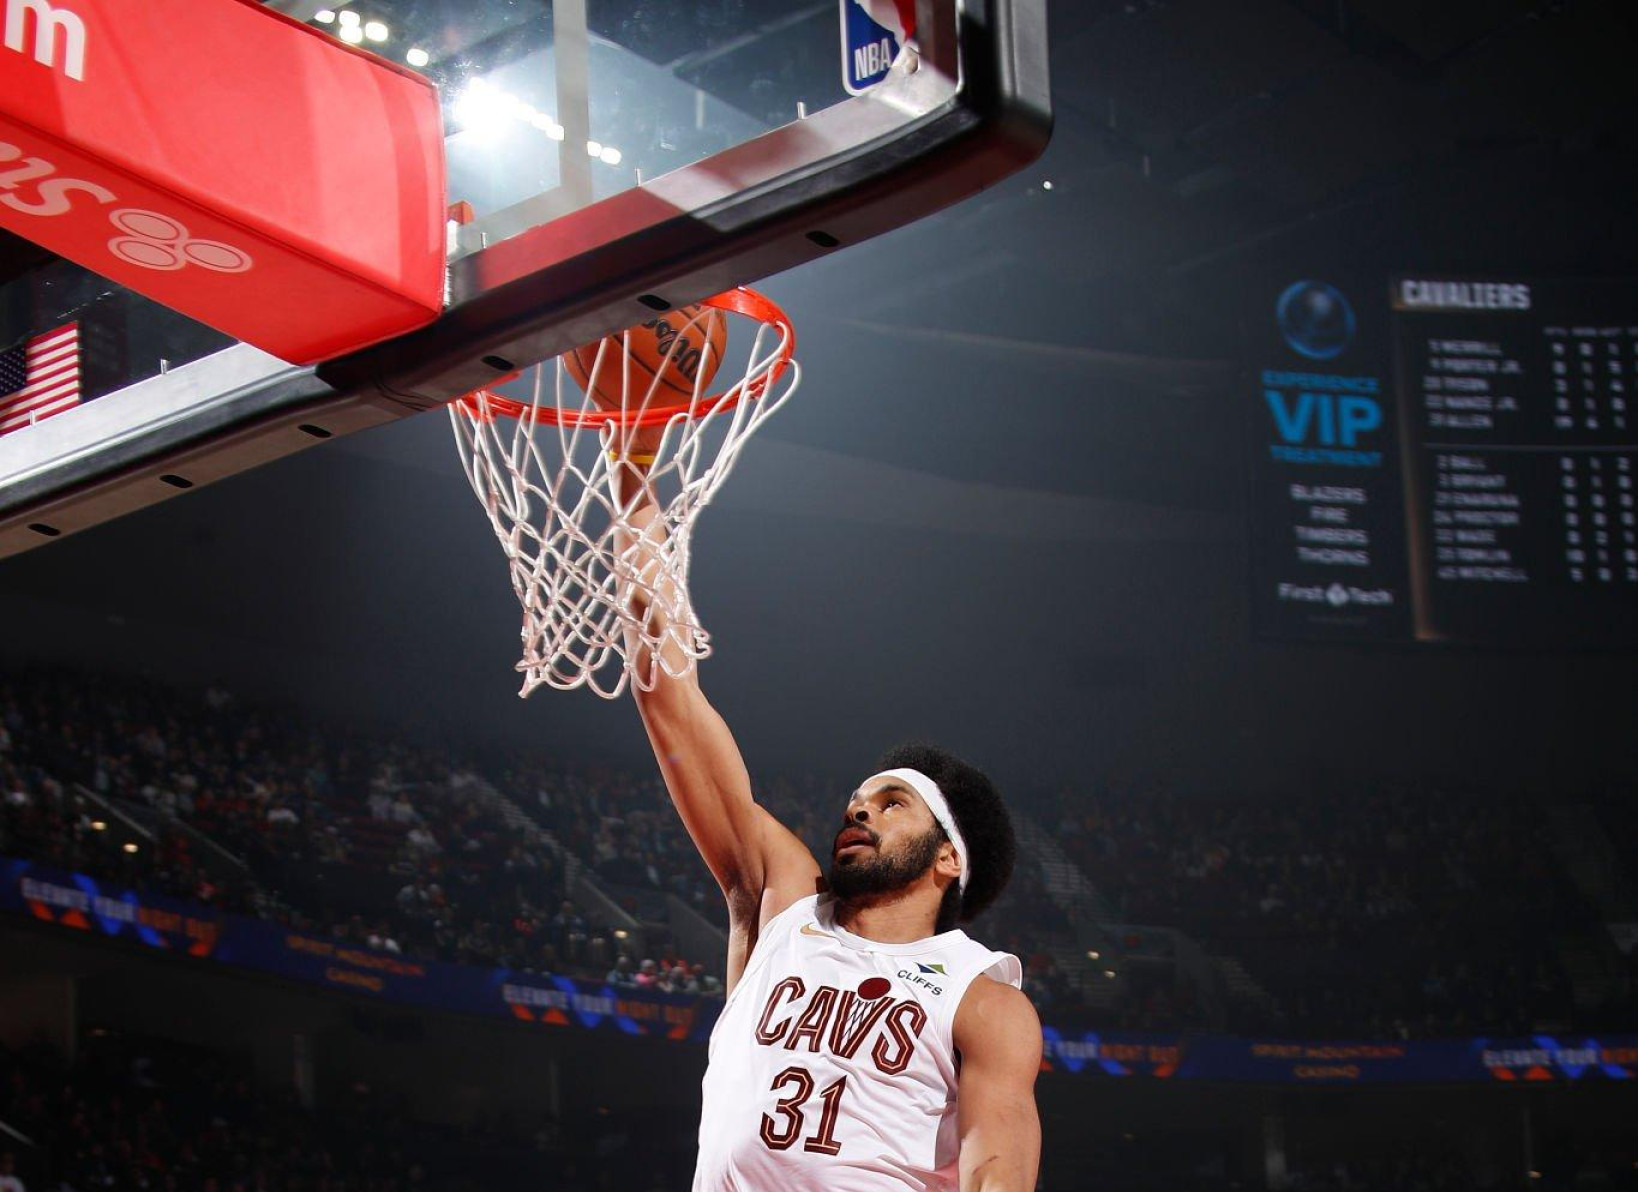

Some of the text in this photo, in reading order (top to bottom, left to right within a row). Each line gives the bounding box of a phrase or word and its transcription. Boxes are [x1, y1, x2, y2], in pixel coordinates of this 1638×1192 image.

[854, 38, 891, 80] NBA
[1403, 280, 1531, 309] CAVALIERS
[1265, 390, 1382, 447] VIP
[897, 969, 943, 996] CLIFFS
[756, 976, 927, 1075] CAVS
[760, 1066, 847, 1156] 31
